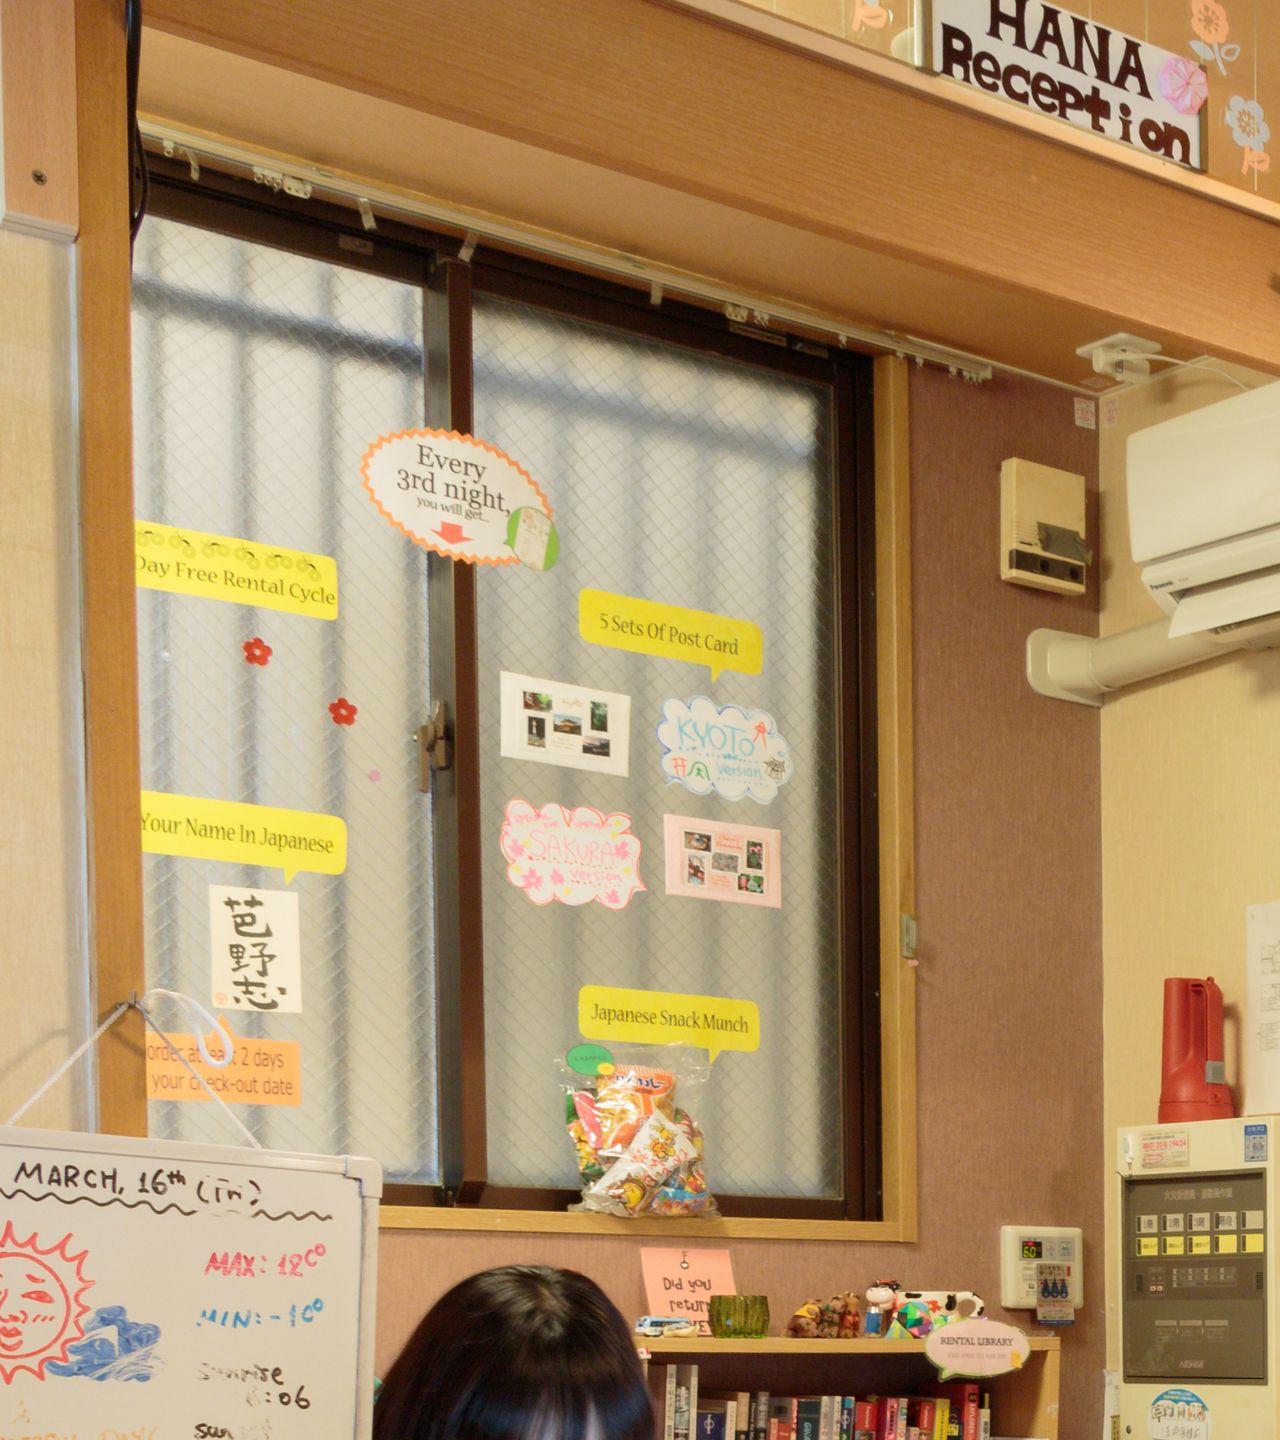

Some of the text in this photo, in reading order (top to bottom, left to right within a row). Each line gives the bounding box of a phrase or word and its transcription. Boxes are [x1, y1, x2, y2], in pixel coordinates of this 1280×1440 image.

[985, 0, 1154, 100] HANA
[941, 23, 1193, 166] Reception
[417, 443, 487, 484] Every
[397, 468, 511, 518] 3rd night,
[416, 496, 438, 511] you
[440, 503, 463, 516] will
[134, 554, 336, 607] Day Free Rental Cycle
[599, 613, 739, 656] 5 Sets Of Post Card
[678, 716, 756, 757] KYOTO
[141, 812, 334, 854] Your Name In Japanese
[528, 829, 617, 866] SAKURA
[591, 1003, 749, 1034] Japanese Snack Munch
[241, 1046, 250, 1066] 2
[253, 1048, 284, 1072] days
[152, 1073, 185, 1092] your
[262, 1075, 294, 1096] date
[14, 1161, 125, 1196] MARCH,
[137, 1168, 187, 1197] 16th
[204, 1252, 267, 1278] MAX:
[663, 1277, 683, 1291] Did
[940, 1337, 1013, 1347] RENTAL LIBRARY
